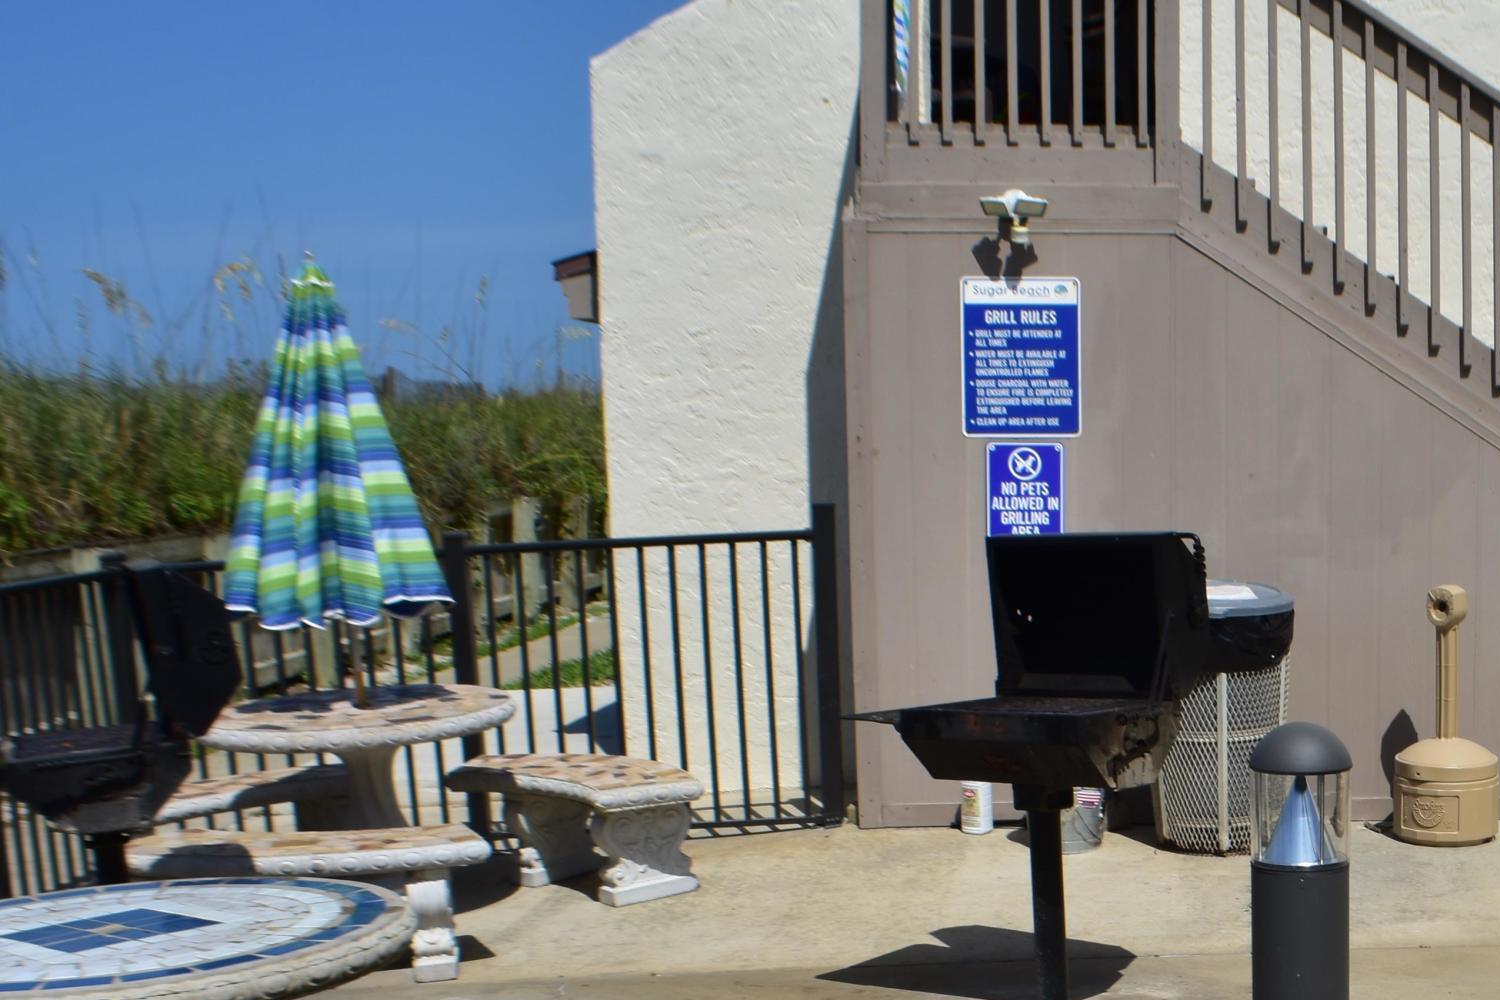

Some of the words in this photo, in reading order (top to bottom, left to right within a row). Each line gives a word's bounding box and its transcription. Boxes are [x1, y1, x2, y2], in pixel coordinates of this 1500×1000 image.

[972, 285, 1008, 297] Sugar
[1012, 285, 1051, 296] Beach
[984, 309, 1017, 326] GRILL
[1020, 309, 1057, 326] RULES
[1022, 329, 1054, 338] ATTENDED
[1054, 329, 1062, 338] AT
[975, 339, 988, 347] ALL
[988, 339, 1008, 347] TIMES
[975, 350, 996, 359] WATER
[1025, 350, 1058, 359] AVAILABLE
[1058, 350, 1067, 359] AT
[975, 359, 988, 368] ALL
[988, 359, 1008, 368] TIMES
[1008, 359, 1018, 368] TO
[1024, 368, 1050, 377] FLAMES
[1048, 379, 1069, 388] WATER
[1012, 388, 1026, 397] FIRE
[1027, 388, 1034, 397] IS
[1021, 397, 1045, 406] BEFORE
[976, 406, 989, 415] THE
[990, 406, 1008, 415] AREA
[976, 417, 997, 426] CLEAN
[997, 417, 1007, 426] UP
[1008, 417, 1025, 426] AREA
[1026, 417, 1046, 426] AFTER
[1046, 417, 1060, 426] USE
[1000, 482, 1017, 496] NO
[1020, 482, 1049, 496] PETS
[991, 496, 1044, 510] ALLOWED
[1047, 496, 1059, 510] IN
[1000, 511, 1050, 525] GRILLING
